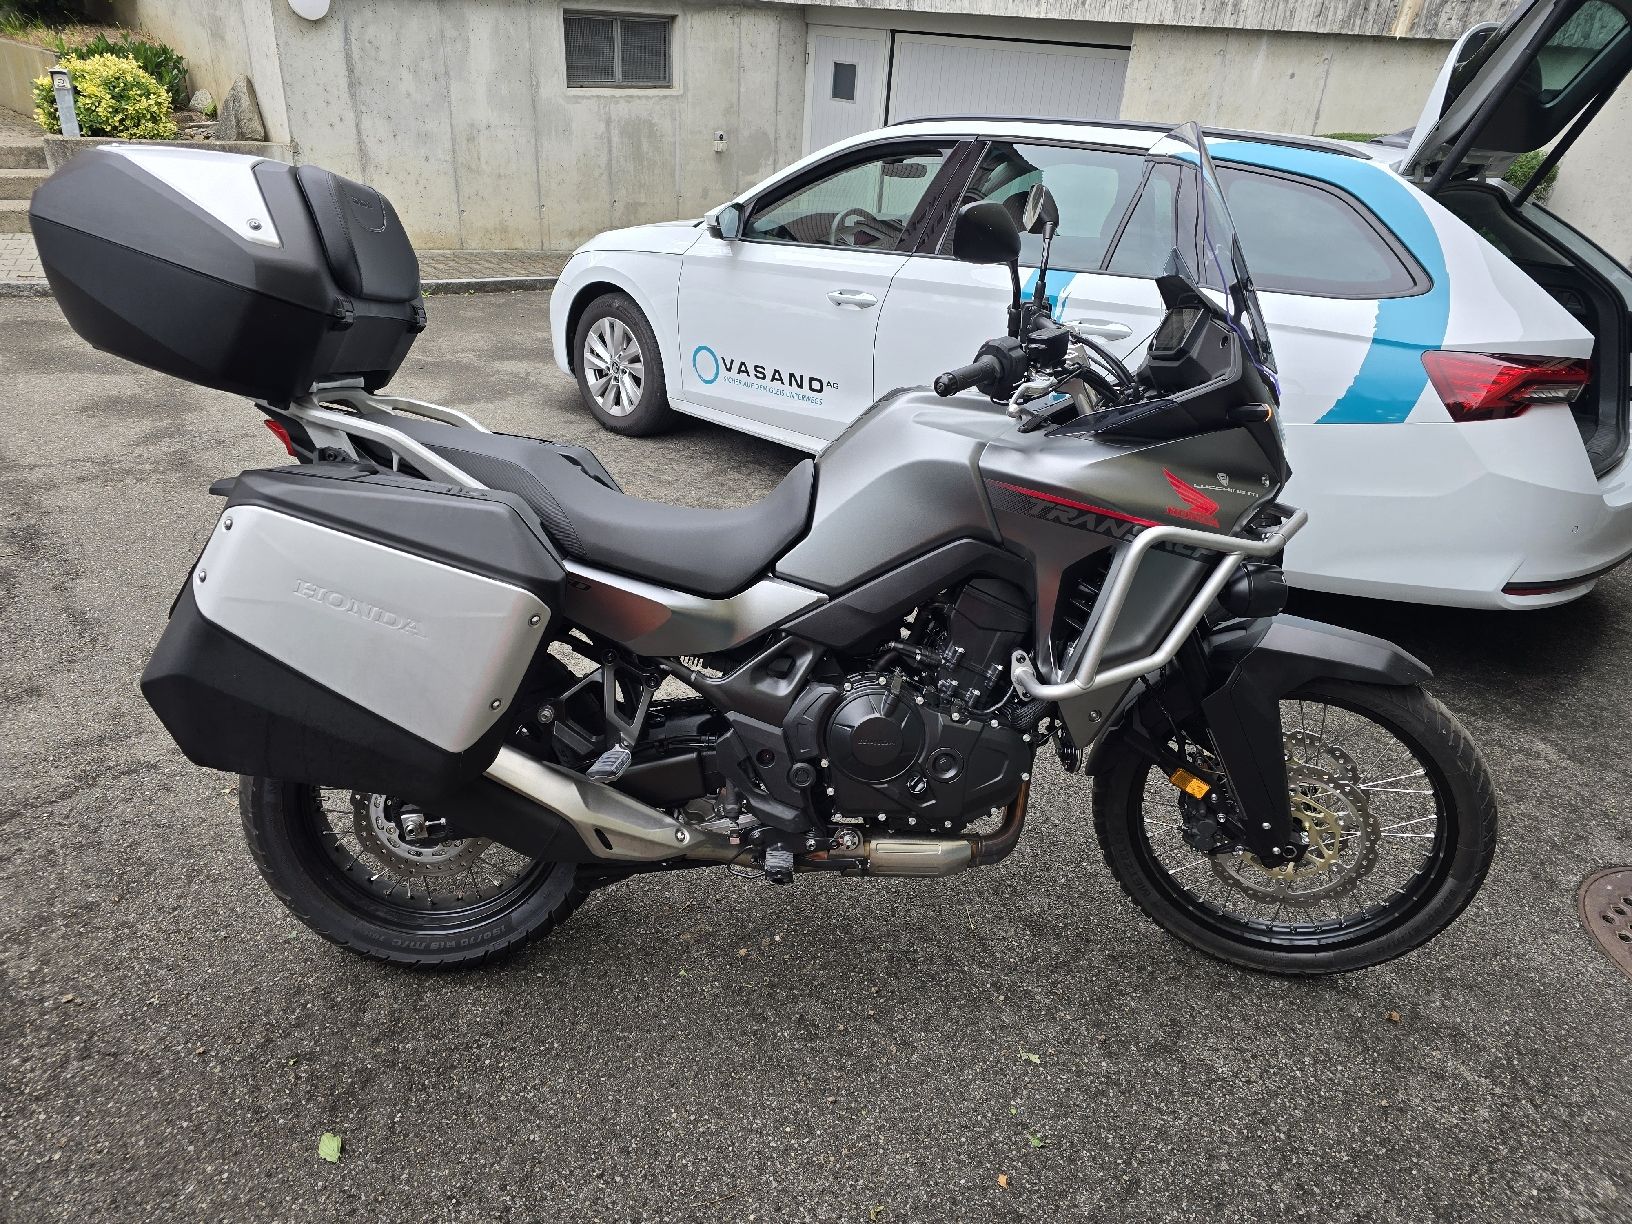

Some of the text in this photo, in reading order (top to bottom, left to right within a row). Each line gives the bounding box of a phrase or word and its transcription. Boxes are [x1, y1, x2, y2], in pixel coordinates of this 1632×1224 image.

[721, 356, 839, 394] VASAND AG
[293, 578, 428, 640] HONDA
